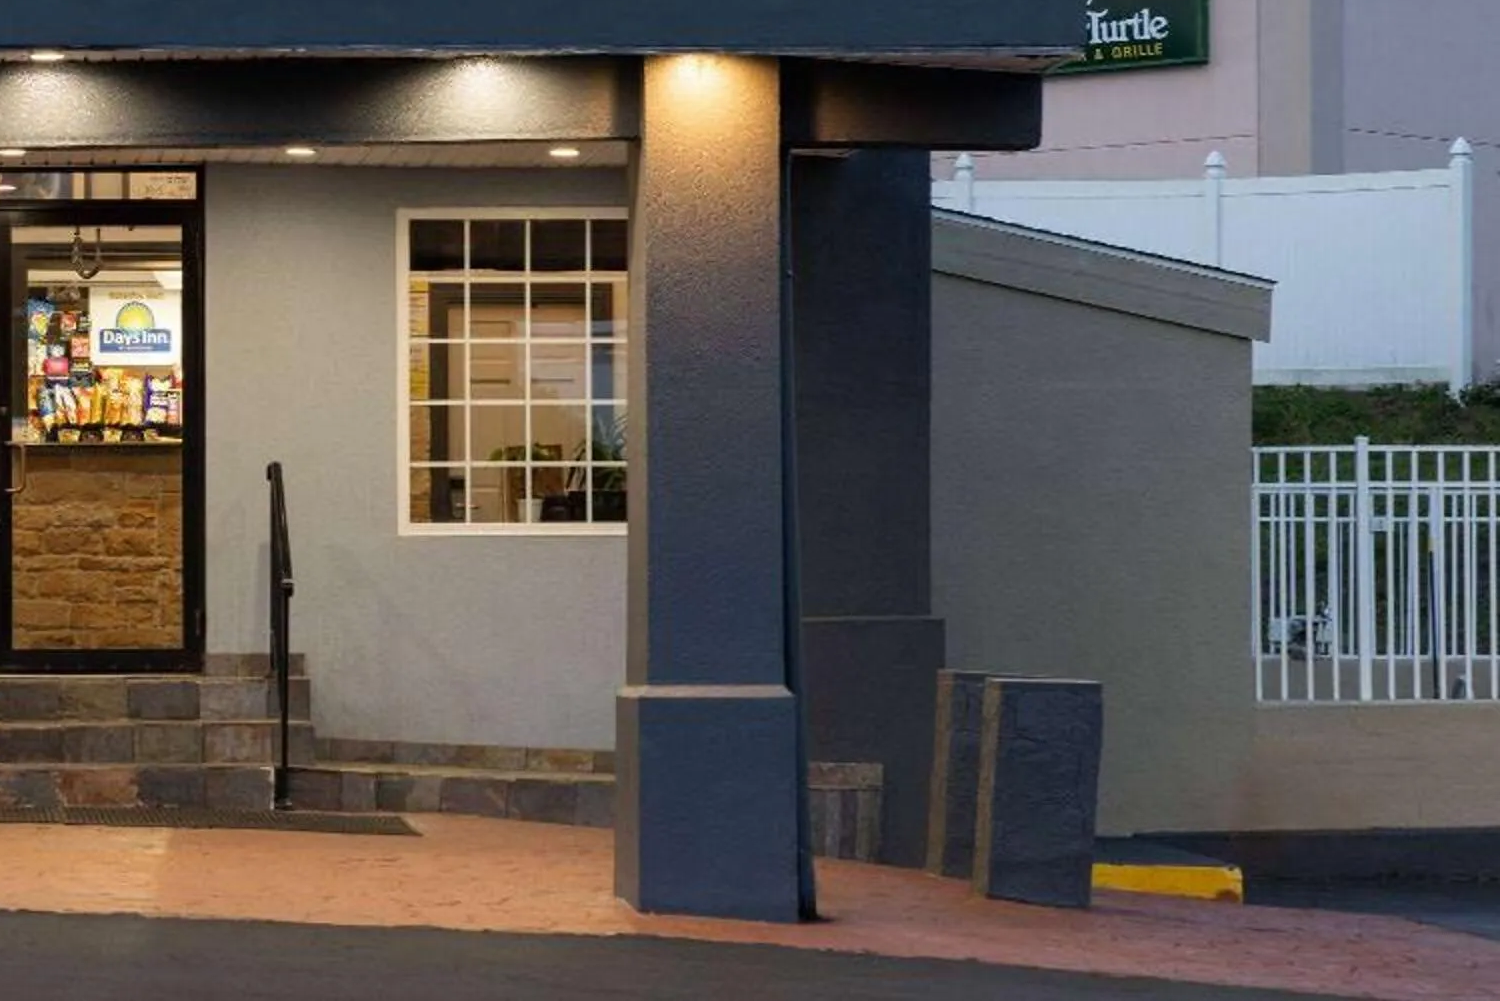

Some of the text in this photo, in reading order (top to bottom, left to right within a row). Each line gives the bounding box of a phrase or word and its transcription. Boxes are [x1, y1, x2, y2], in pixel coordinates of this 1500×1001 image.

[1086, 8, 1169, 44] Turtle
[1111, 42, 1164, 59] GRILLE
[103, 330, 168, 346] Days Inn
